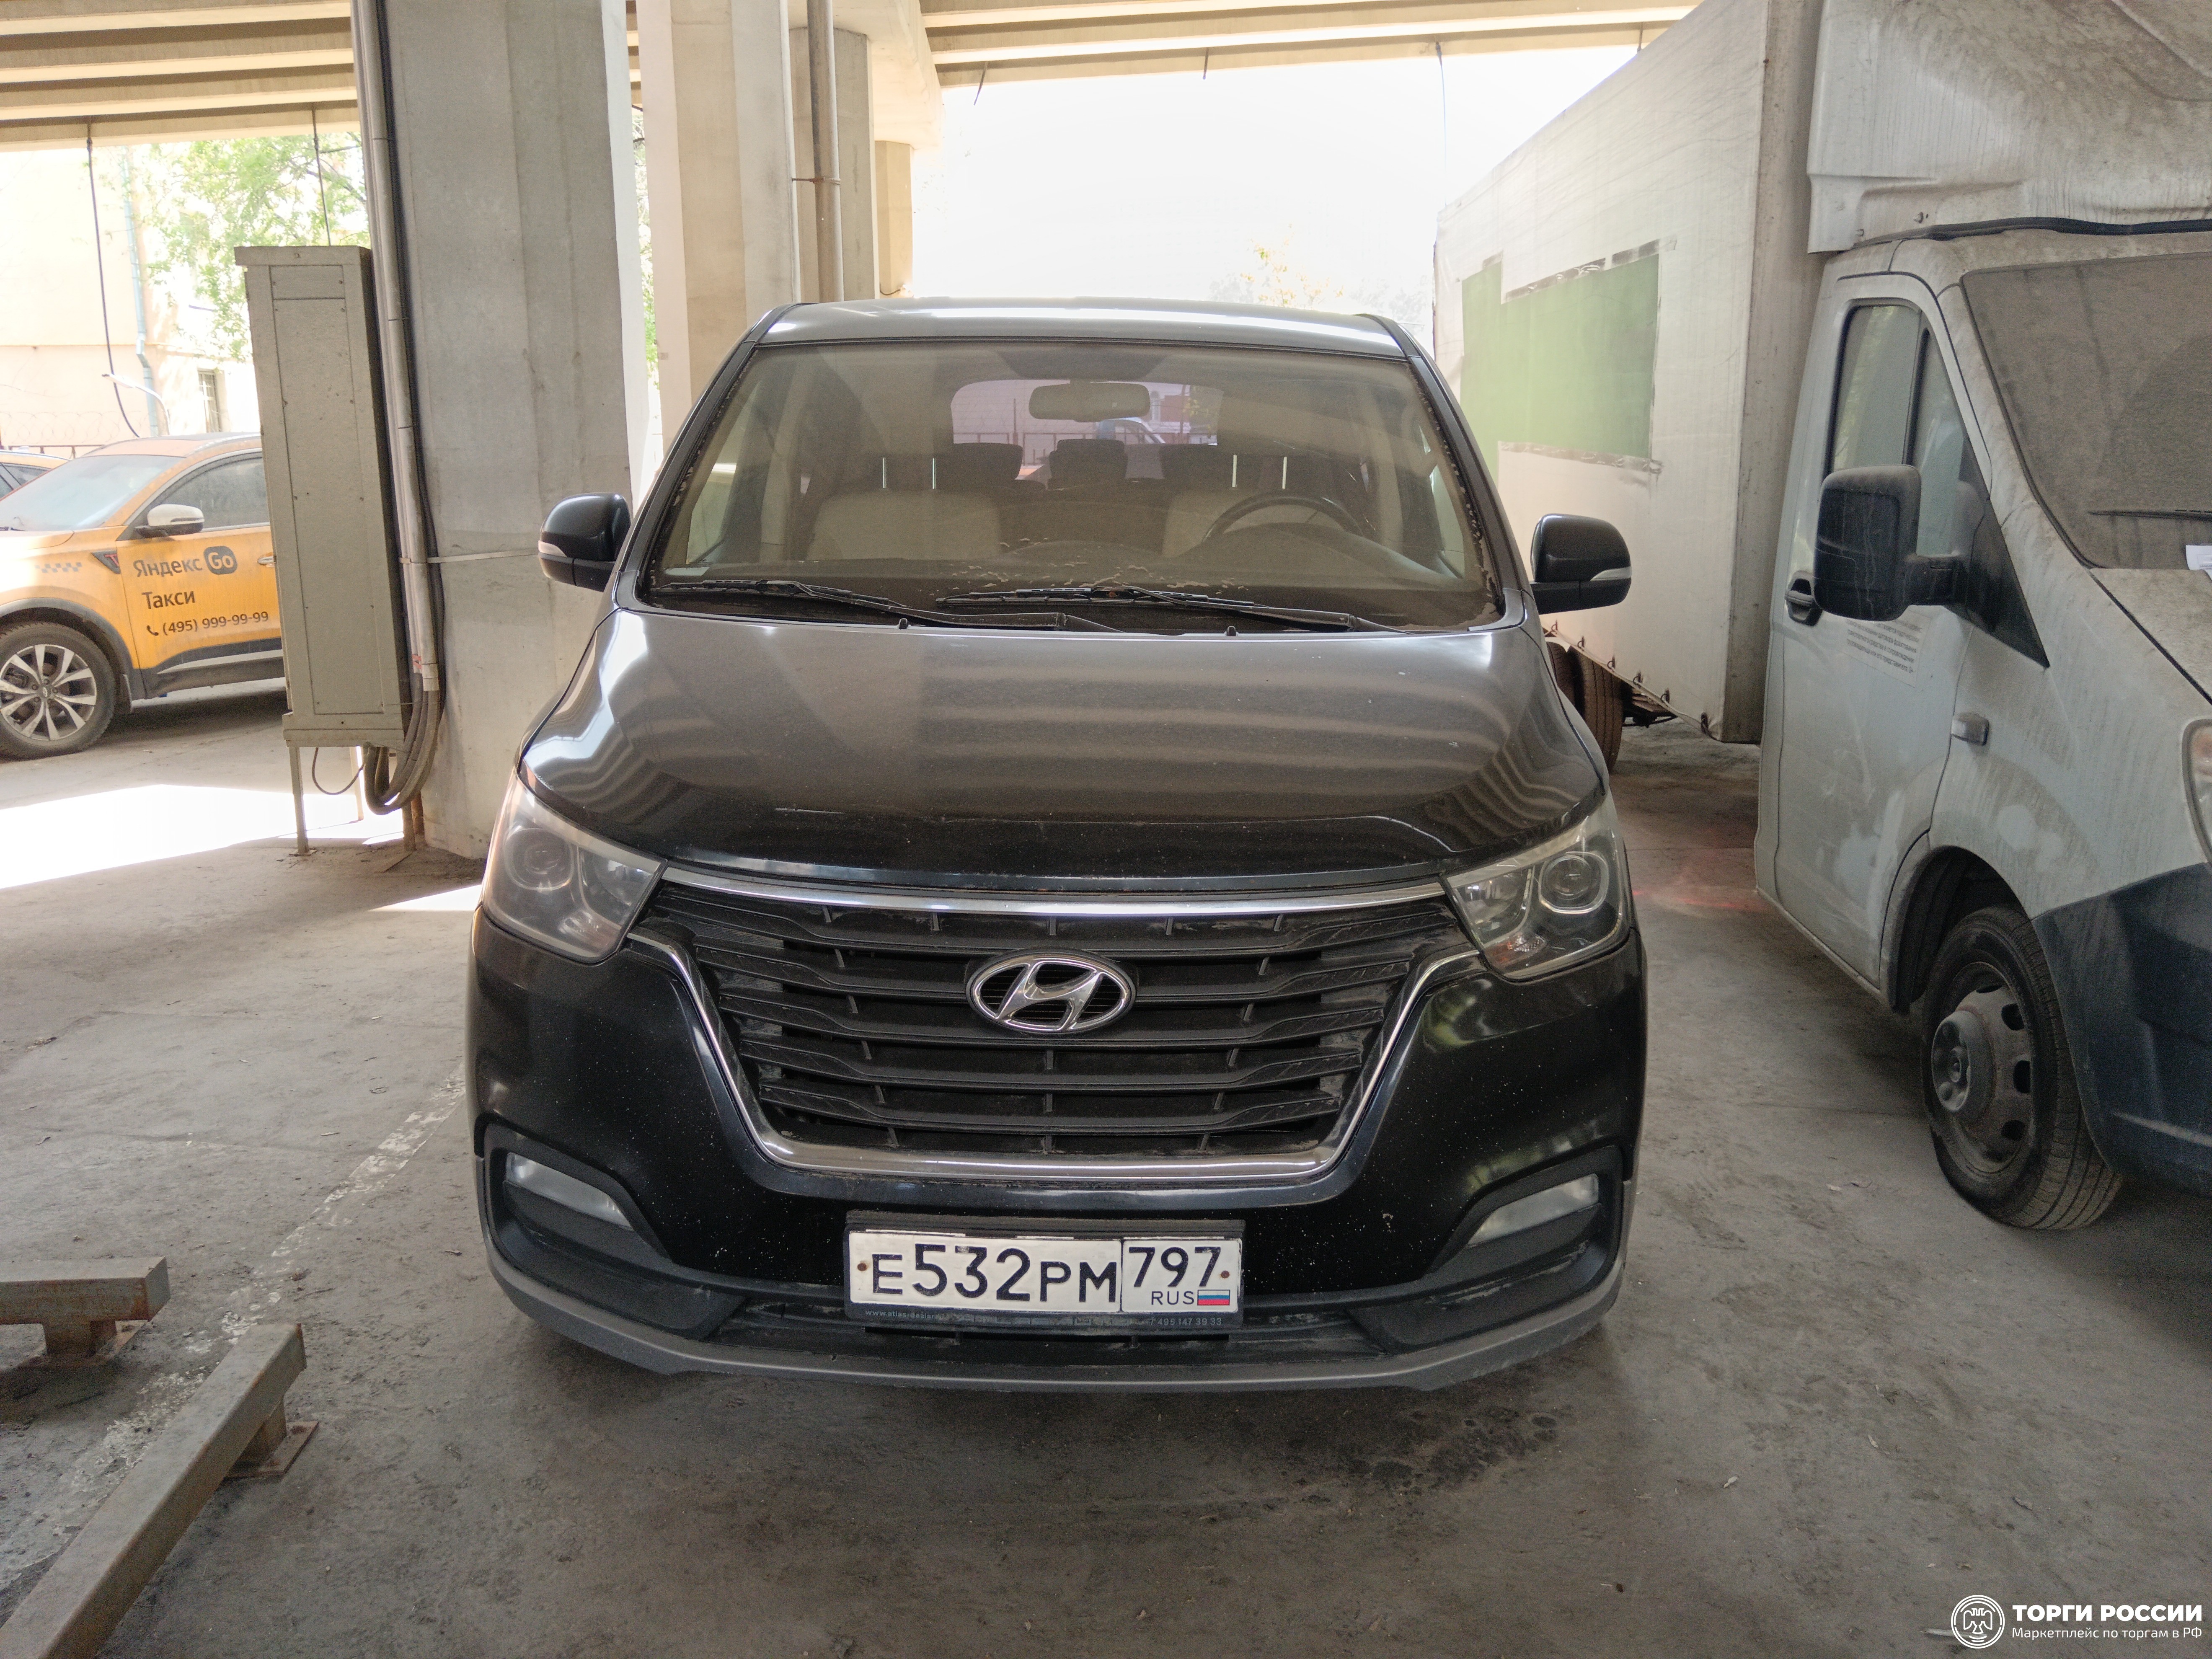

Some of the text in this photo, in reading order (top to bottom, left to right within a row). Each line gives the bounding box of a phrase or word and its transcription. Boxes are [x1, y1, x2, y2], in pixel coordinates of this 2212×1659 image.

[133, 552, 233, 577] Яндекс Go
[142, 591, 196, 609] Такси
[163, 611, 269, 636] (495) 999-99-99
[1128, 1246, 1221, 1287] 797
[1151, 1290, 1194, 1306] RUS
